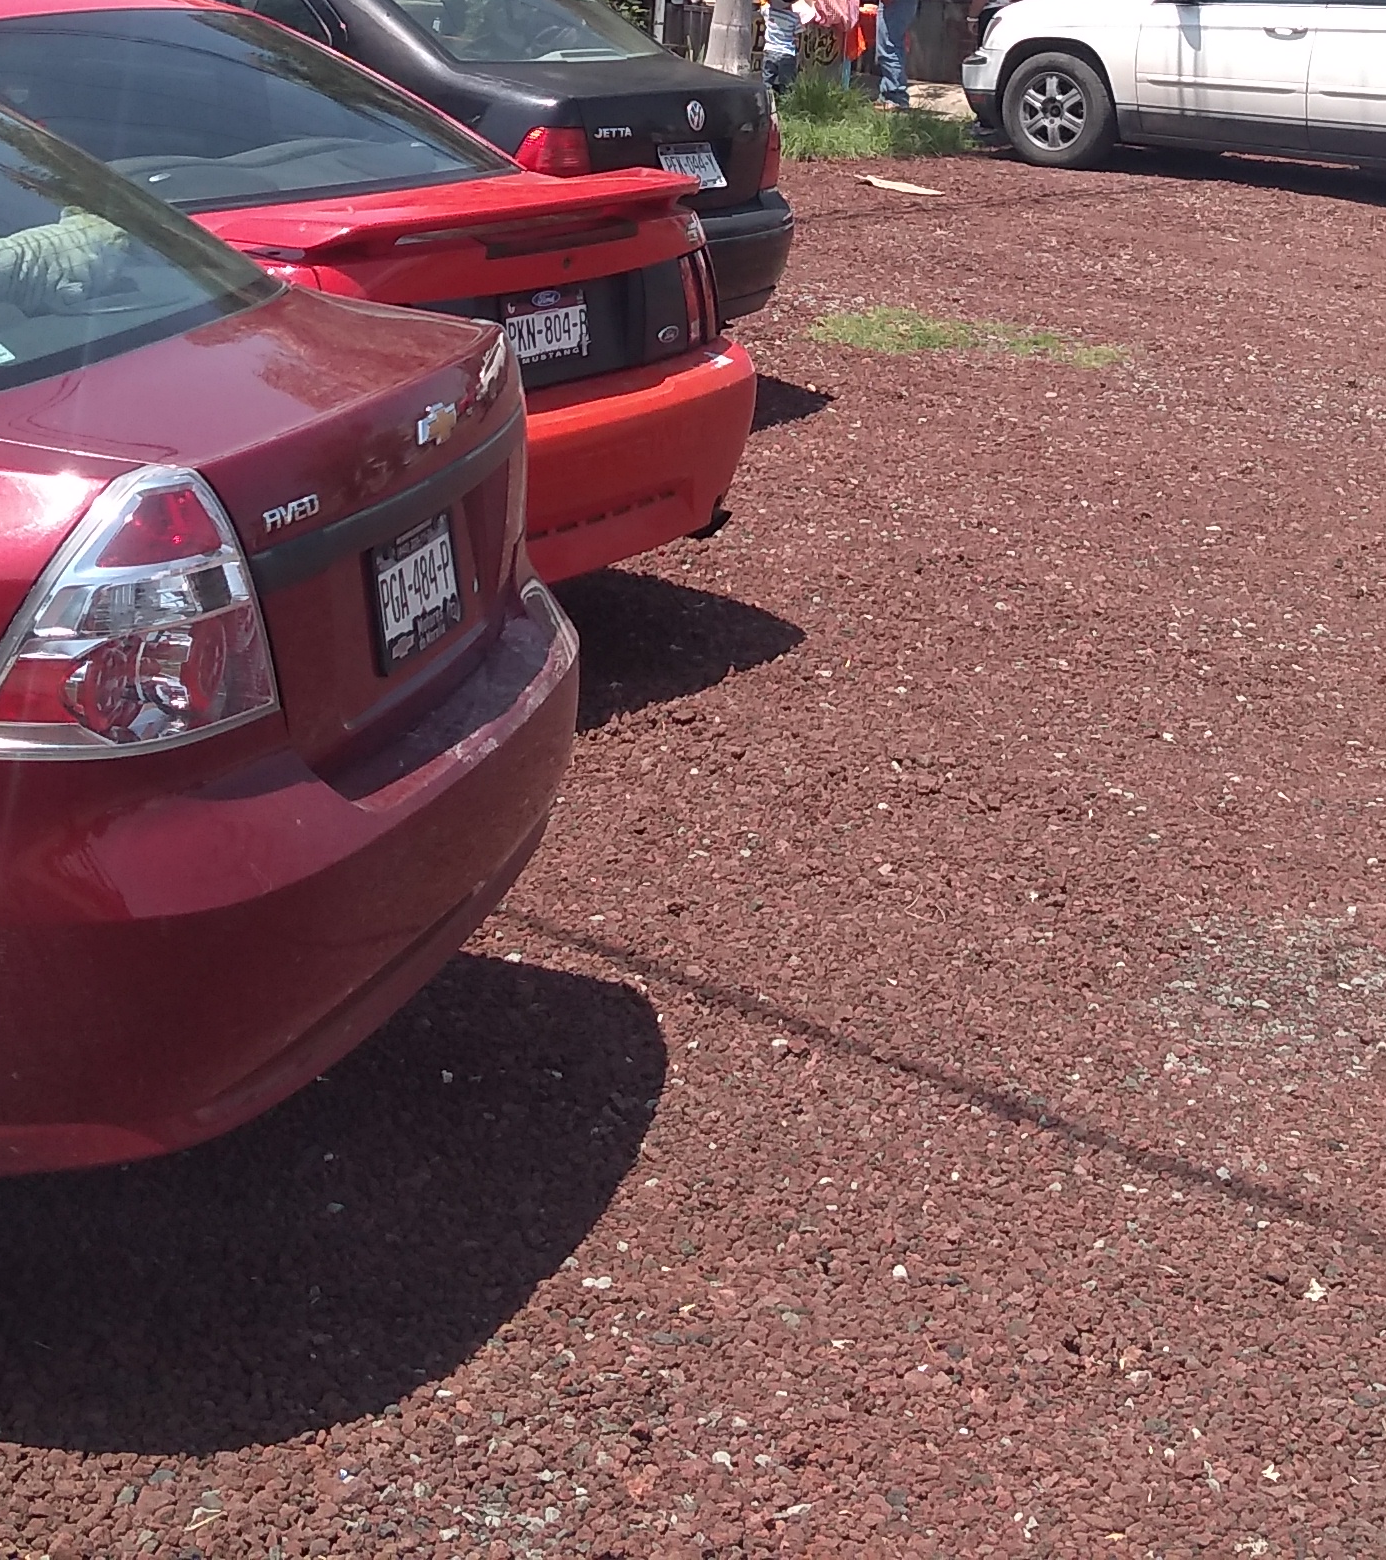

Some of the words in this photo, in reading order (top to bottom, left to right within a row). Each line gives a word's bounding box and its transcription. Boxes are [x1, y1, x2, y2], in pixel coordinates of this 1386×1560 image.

[594, 127, 632, 139] JETTA
[522, 347, 580, 364] MUSTANG
[263, 493, 319, 533] AVEO
[380, 540, 450, 631] PGA-484-P
